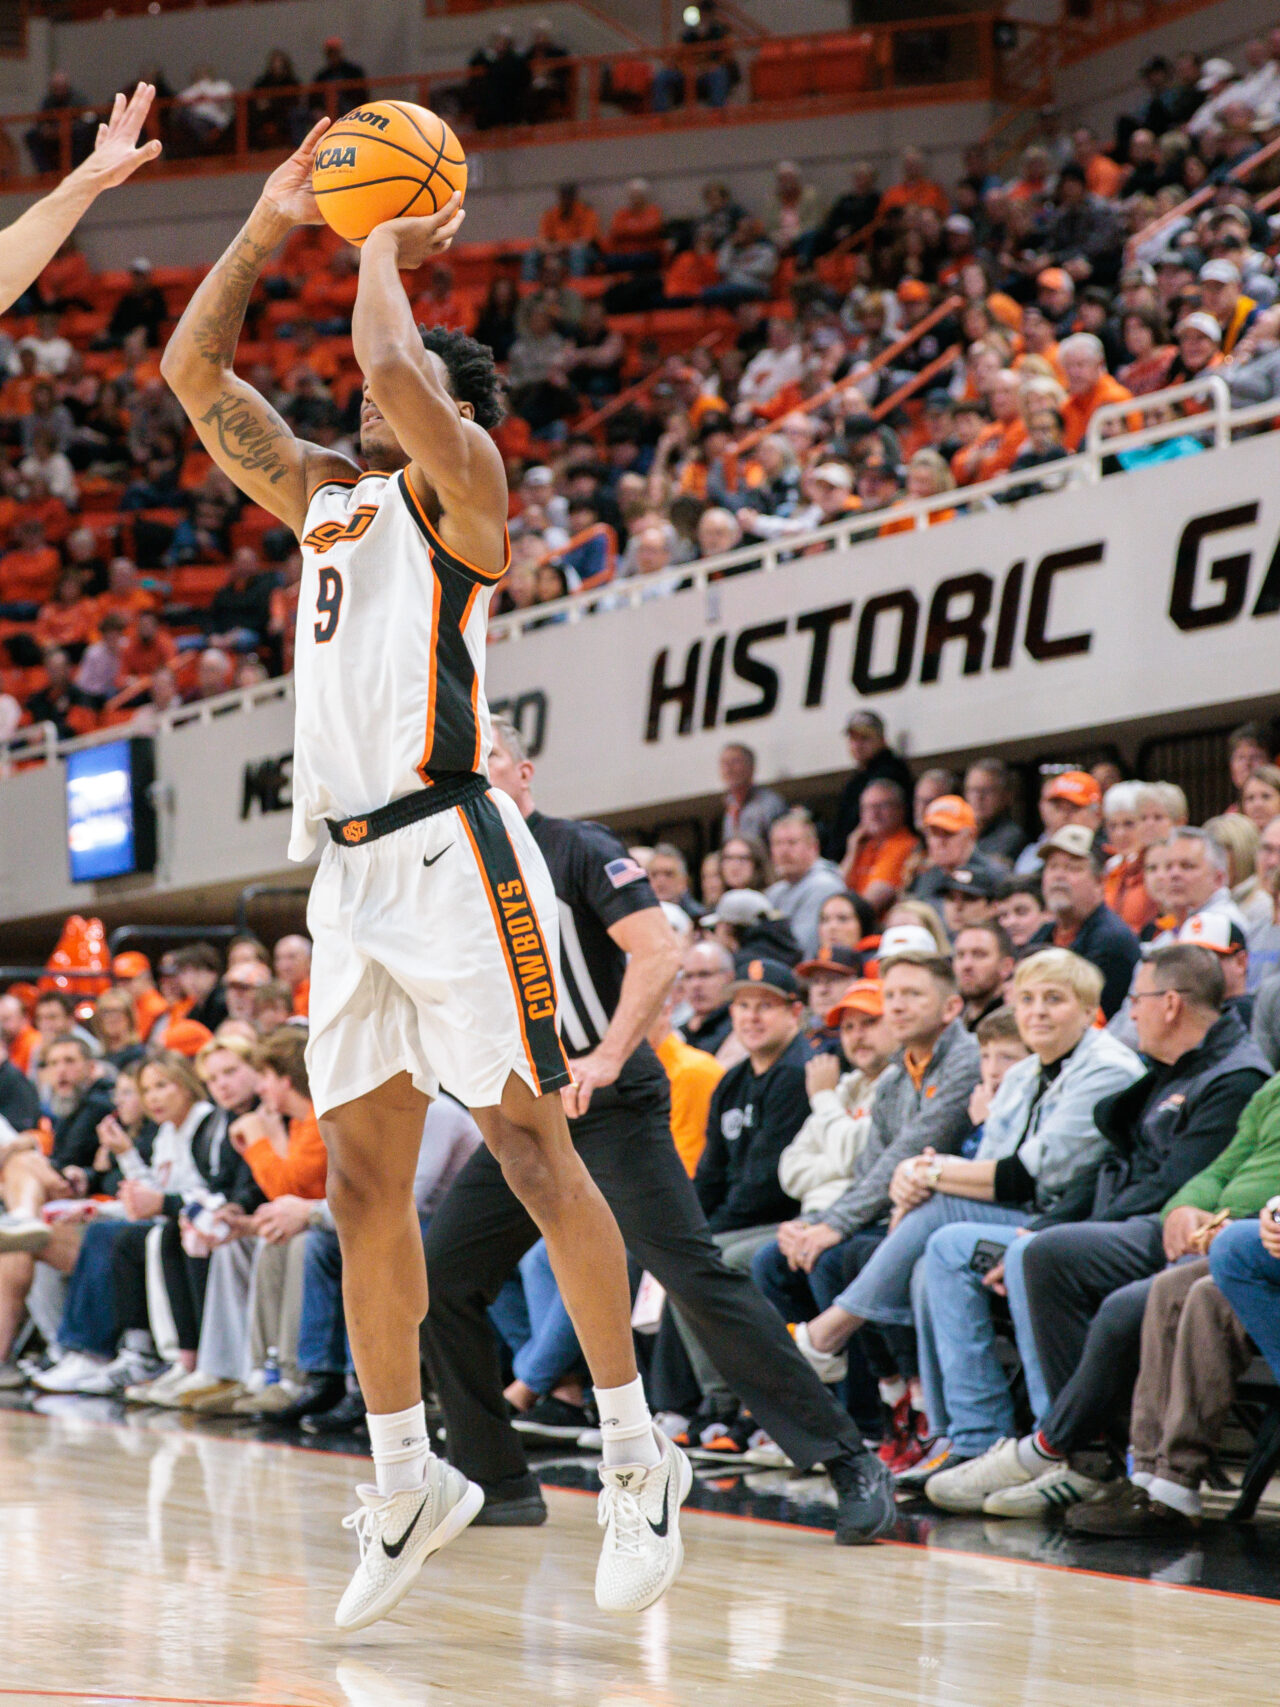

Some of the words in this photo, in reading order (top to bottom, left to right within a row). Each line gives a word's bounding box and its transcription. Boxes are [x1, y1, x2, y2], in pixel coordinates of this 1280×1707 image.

[314, 565, 344, 645] 9
[645, 539, 1106, 744] HISTORIC
[497, 878, 556, 1021] COWBOYS
